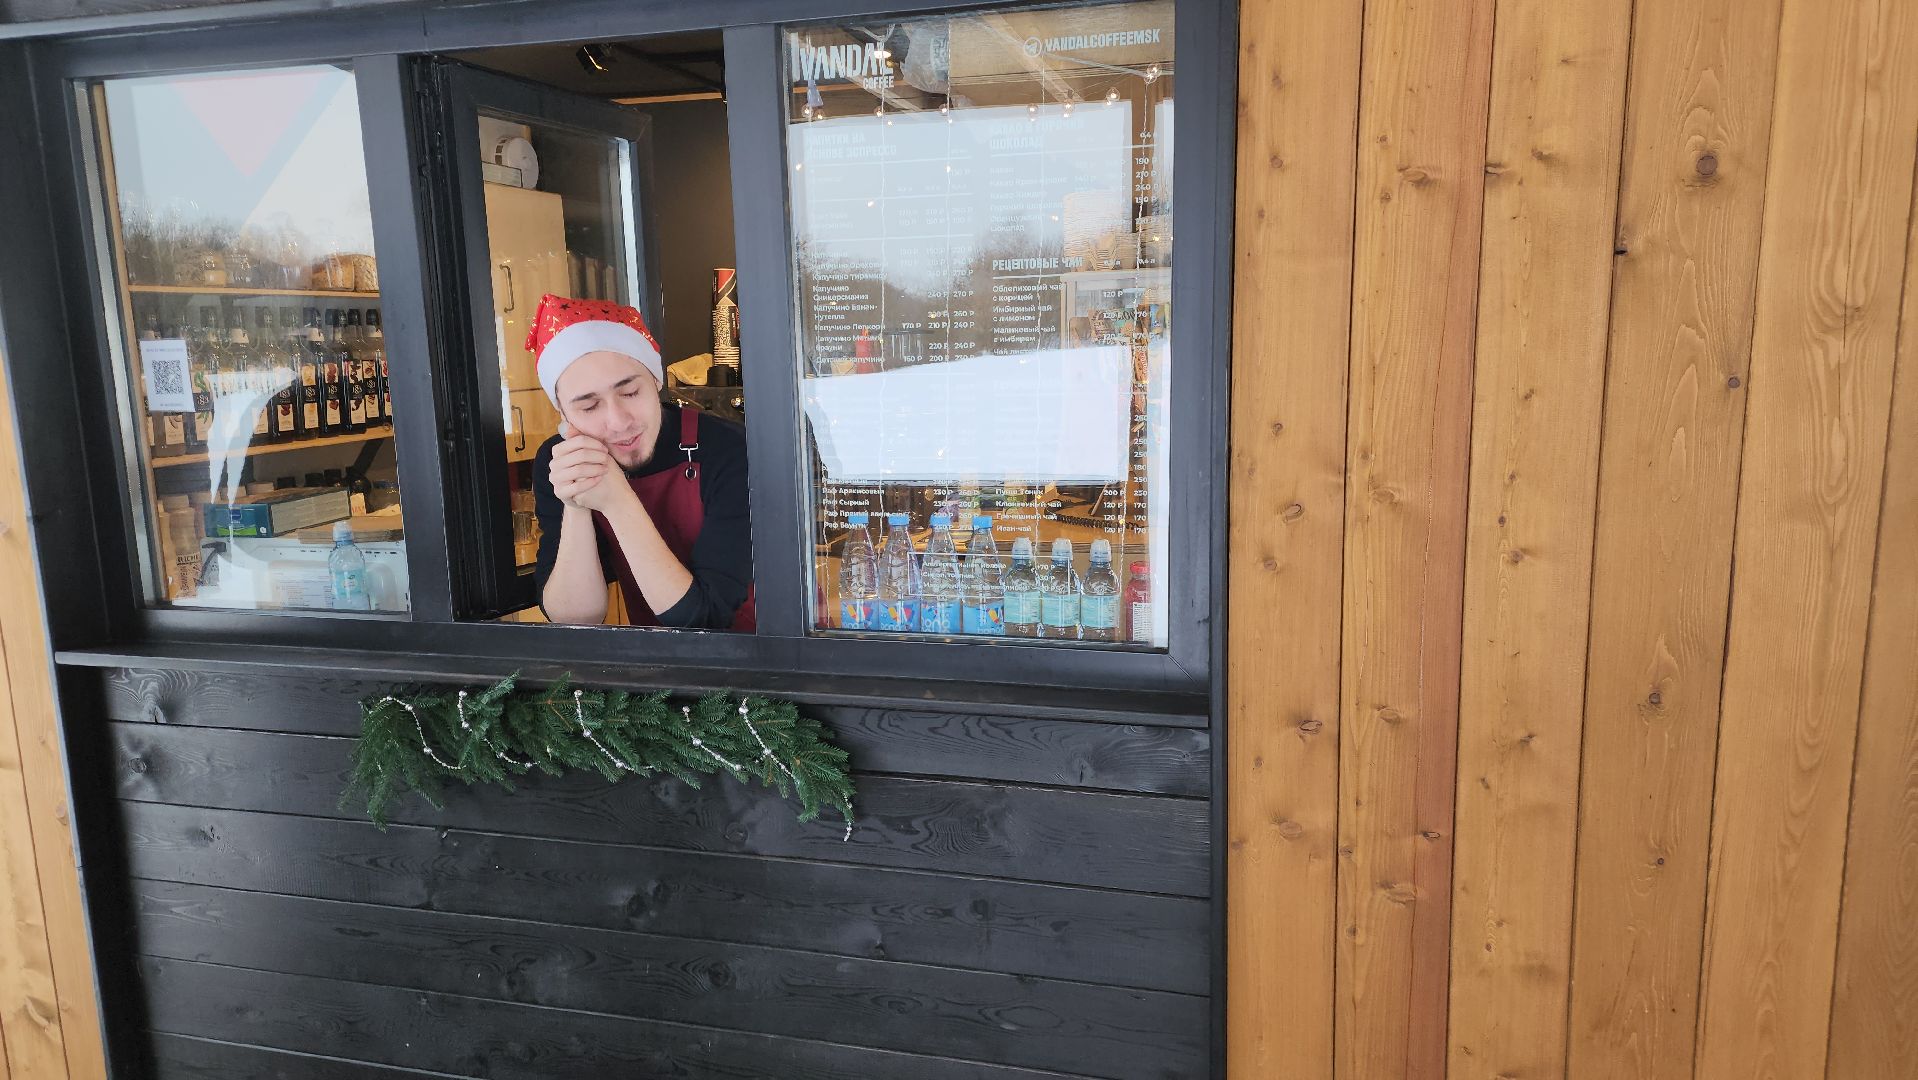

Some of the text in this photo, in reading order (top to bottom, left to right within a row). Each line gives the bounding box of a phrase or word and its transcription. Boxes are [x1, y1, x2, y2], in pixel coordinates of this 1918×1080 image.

[1044, 28, 1160, 52] VANDALCOFFEEMSK
[800, 42, 894, 80] VANDAL
[862, 76, 894, 88] COFFEE
[992, 258, 1059, 271] РЕЦЕПТОВЫЕ
[812, 285, 850, 294] Капучино
[992, 284, 1048, 293] Облепиховый
[814, 304, 850, 312] Капучино
